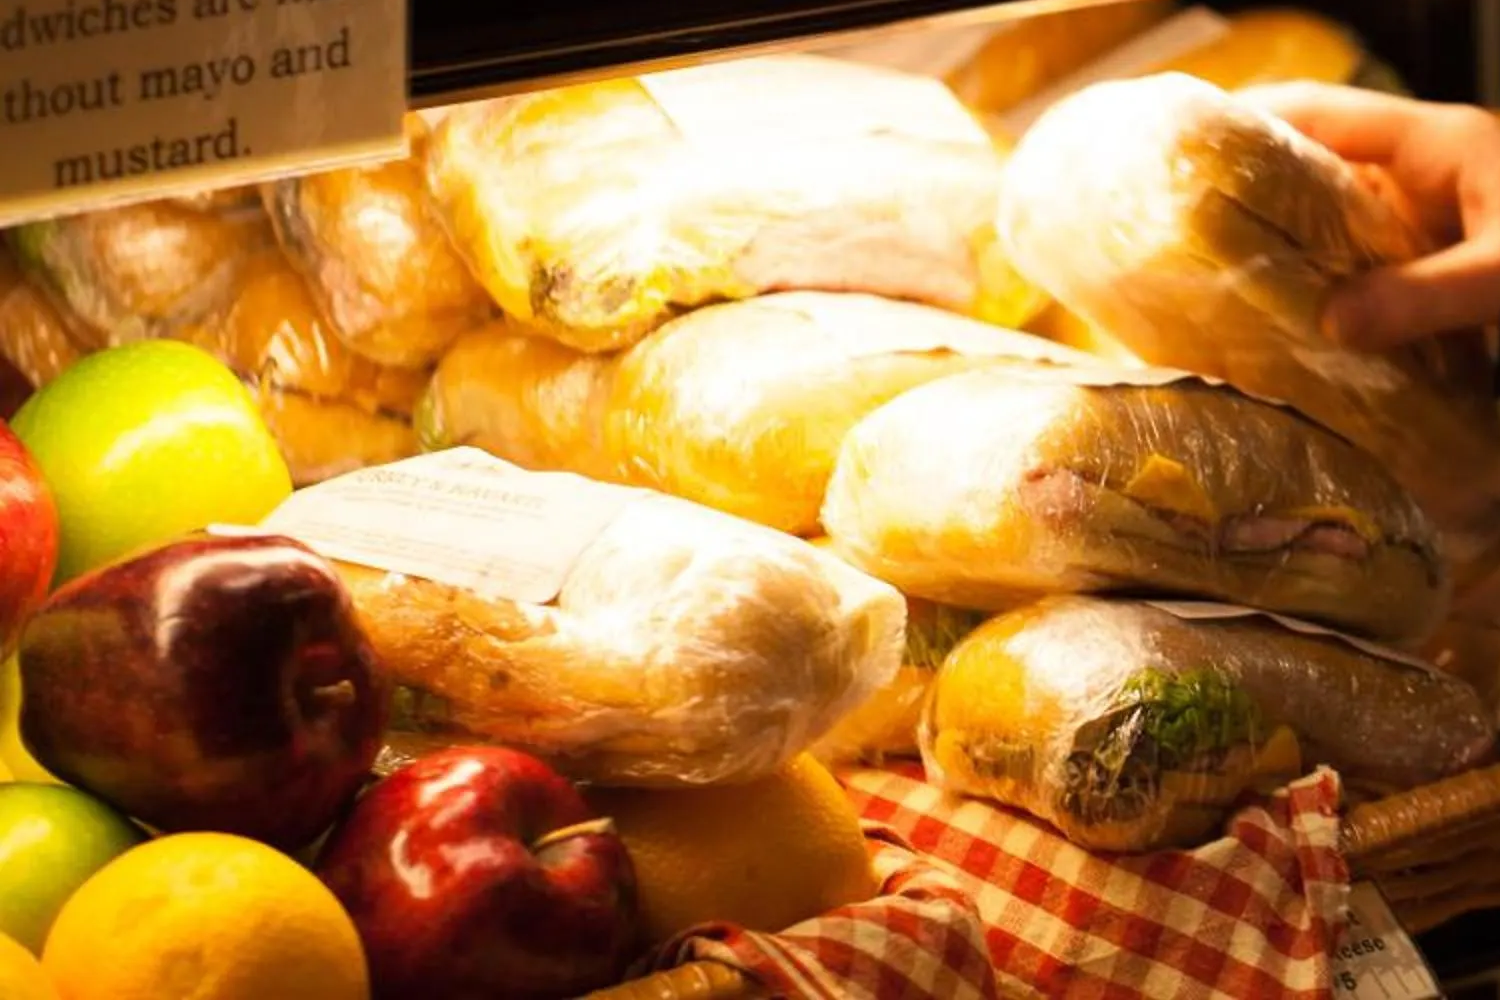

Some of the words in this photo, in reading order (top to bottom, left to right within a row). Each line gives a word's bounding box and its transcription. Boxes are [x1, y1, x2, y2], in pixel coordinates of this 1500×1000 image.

[140, 55, 256, 100] mayo
[270, 26, 351, 78] and
[54, 118, 252, 188] mustard.
